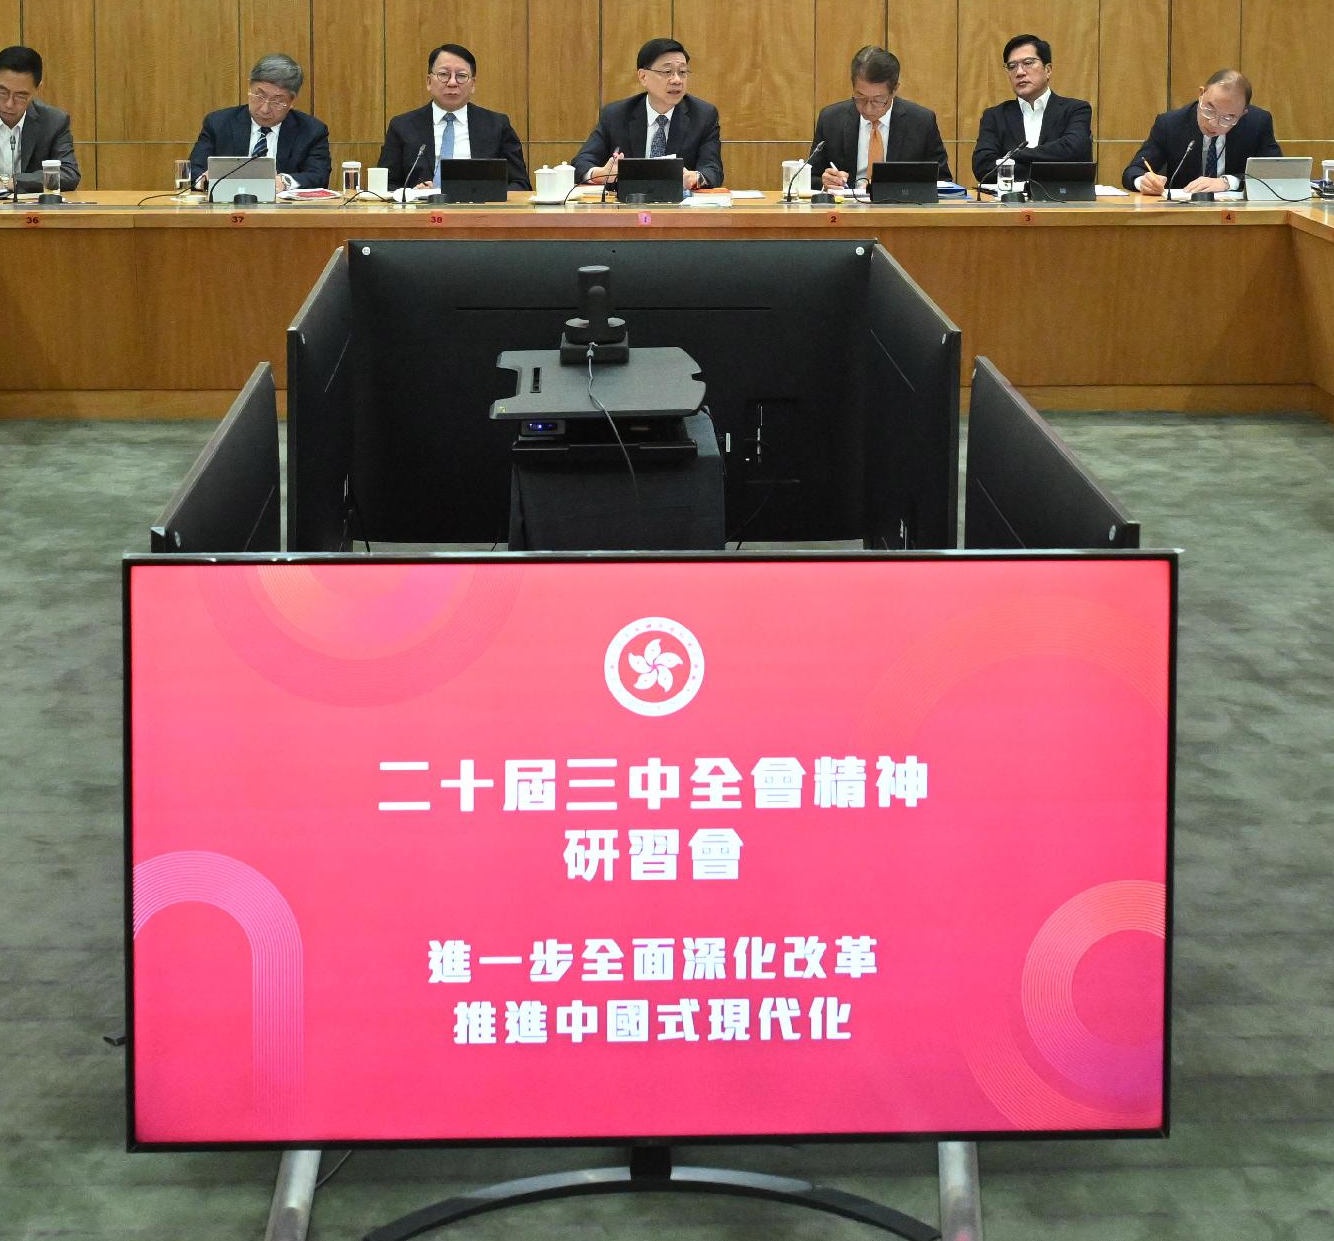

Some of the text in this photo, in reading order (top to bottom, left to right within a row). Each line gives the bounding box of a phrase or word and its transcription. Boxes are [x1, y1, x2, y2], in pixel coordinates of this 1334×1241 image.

[26, 216, 39, 224] 36
[378, 755, 929, 812] 二十屆三中全會精神
[562, 827, 744, 882] 研習會
[427, 935, 878, 984] 進一步全面深化改革
[453, 996, 852, 1045] 推進中國式現代化
